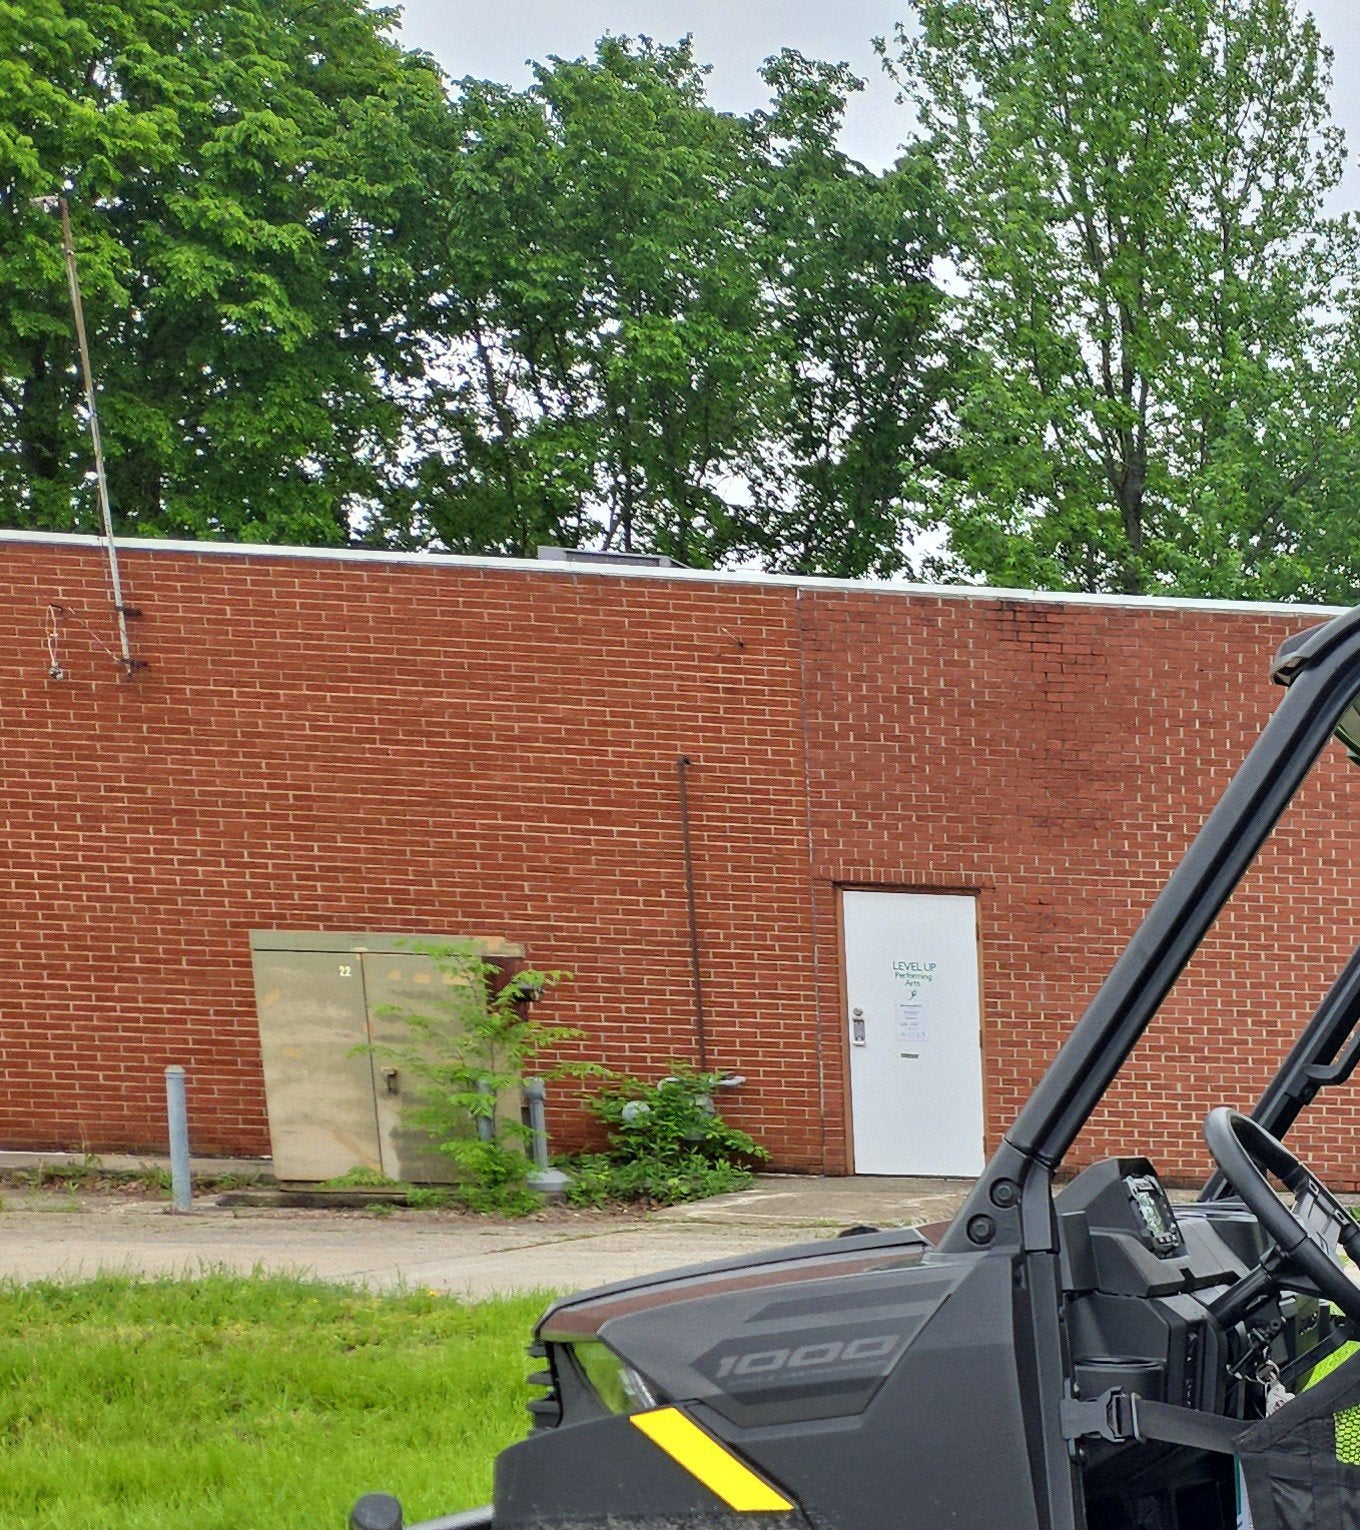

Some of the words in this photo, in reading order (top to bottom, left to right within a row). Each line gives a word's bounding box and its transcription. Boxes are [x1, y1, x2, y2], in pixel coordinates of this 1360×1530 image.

[892, 961, 922, 971] LEVEL
[924, 962, 937, 971] UP
[895, 971, 933, 982] Performing
[715, 1334, 900, 1379] 1000
